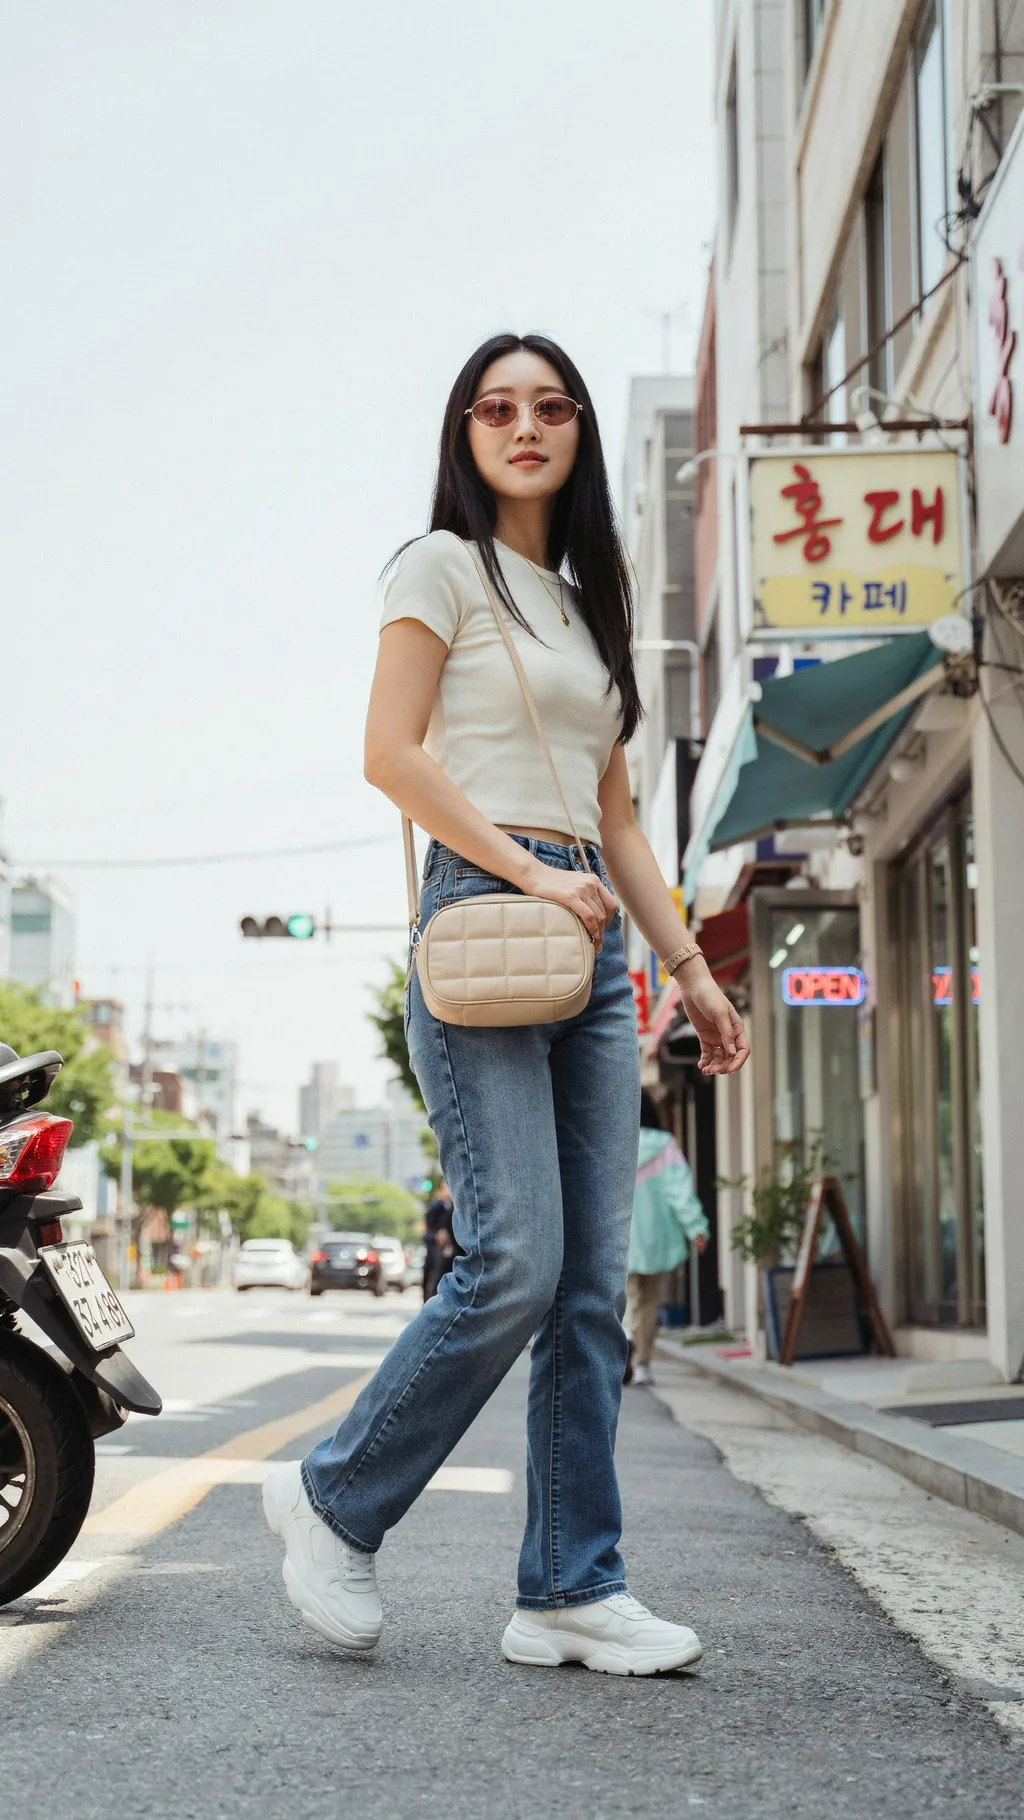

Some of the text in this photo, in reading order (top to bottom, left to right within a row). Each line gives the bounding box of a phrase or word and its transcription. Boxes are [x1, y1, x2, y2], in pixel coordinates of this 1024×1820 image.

[989, 246, 1024, 444] 홍
[773, 464, 944, 563] 홍대
[811, 580, 907, 615] 카페
[788, 972, 861, 1001] OPEN
